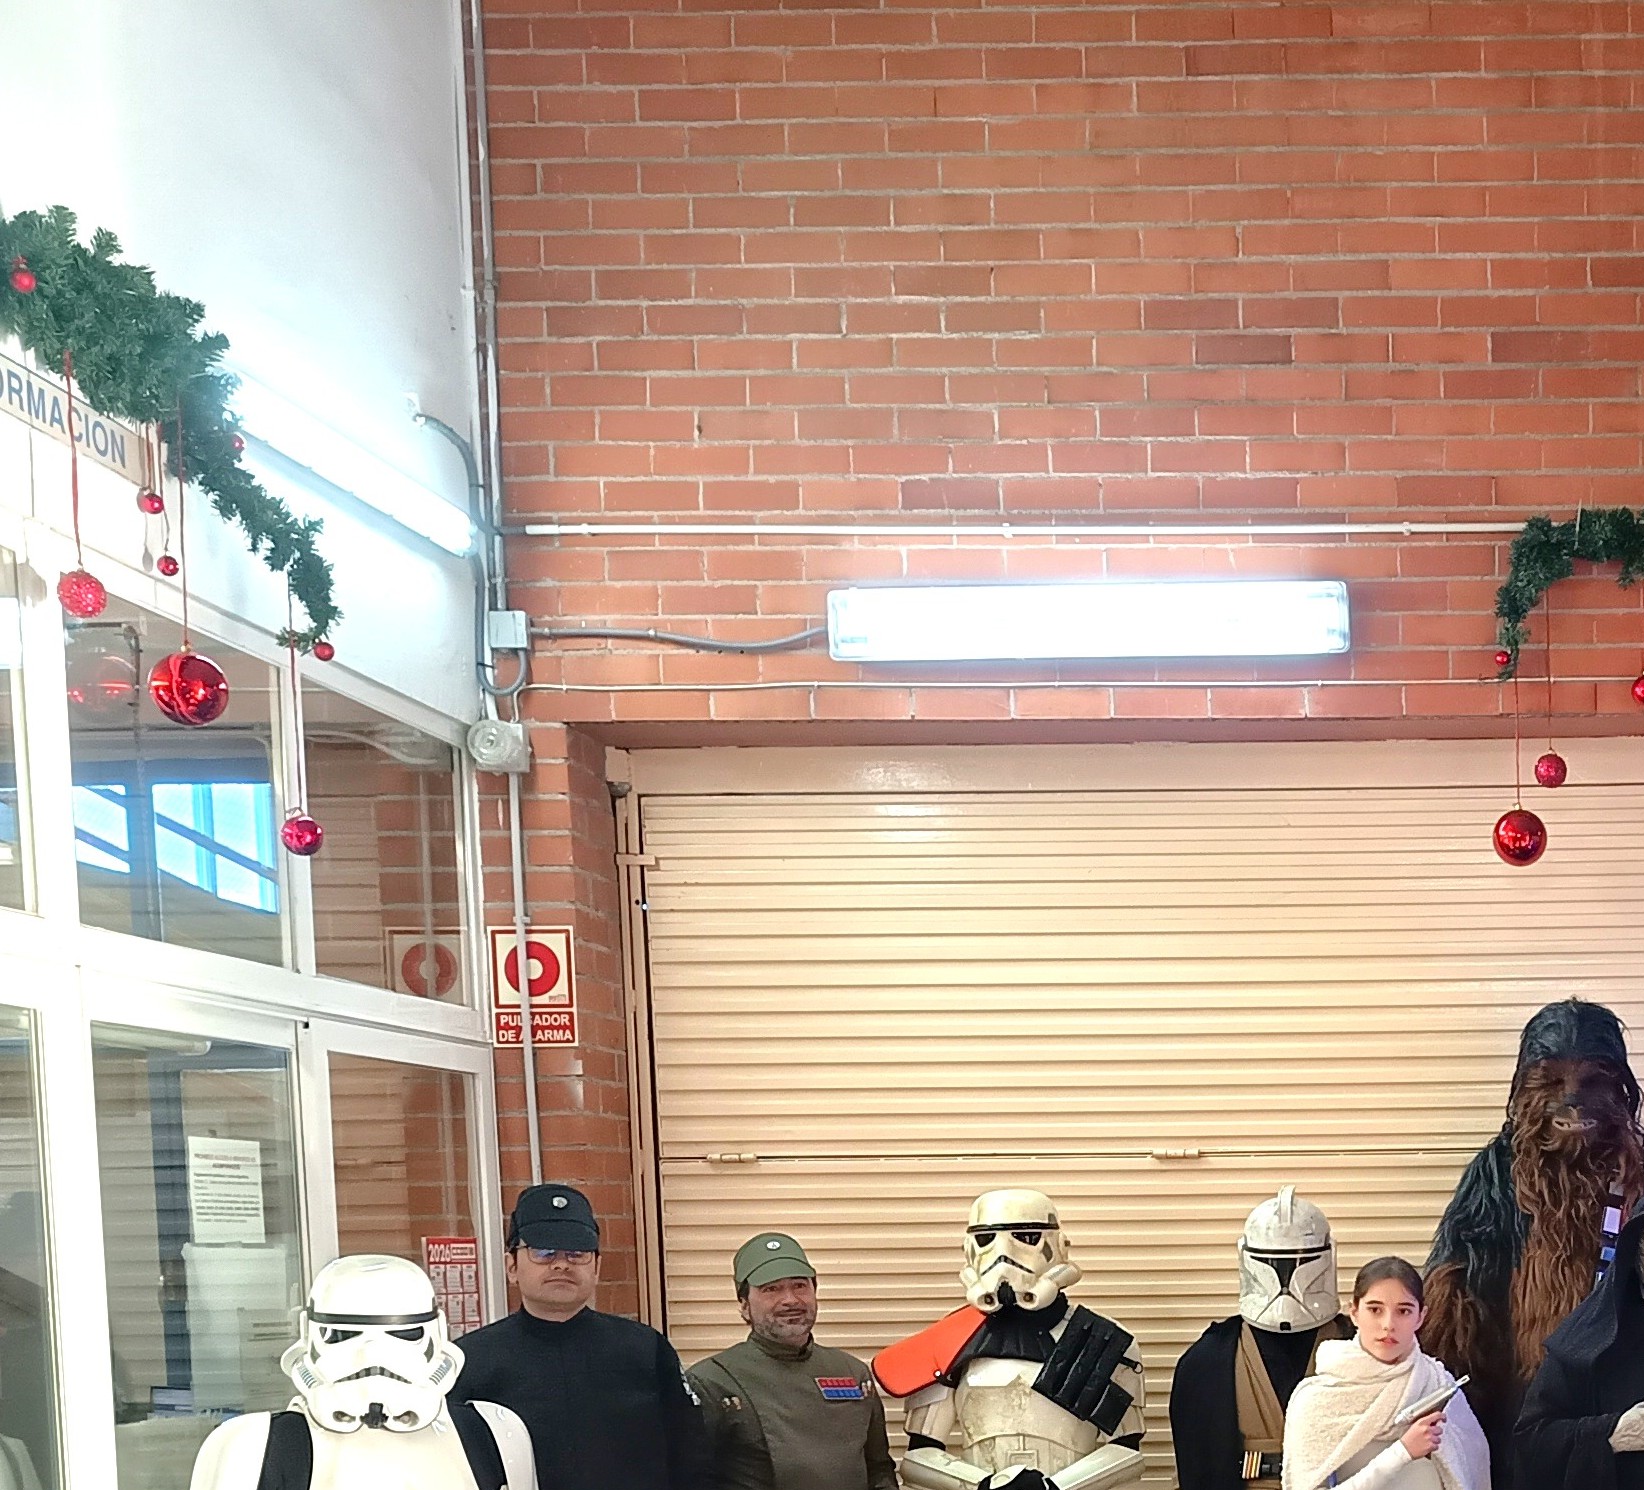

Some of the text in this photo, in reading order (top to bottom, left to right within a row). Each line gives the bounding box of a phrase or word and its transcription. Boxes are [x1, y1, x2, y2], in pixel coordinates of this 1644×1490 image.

[0, 368, 126, 469] RMACION
[500, 1014, 571, 1027] PULADOR
[499, 1029, 573, 1042] DE ARMA
[428, 1244, 451, 1262] 2026
